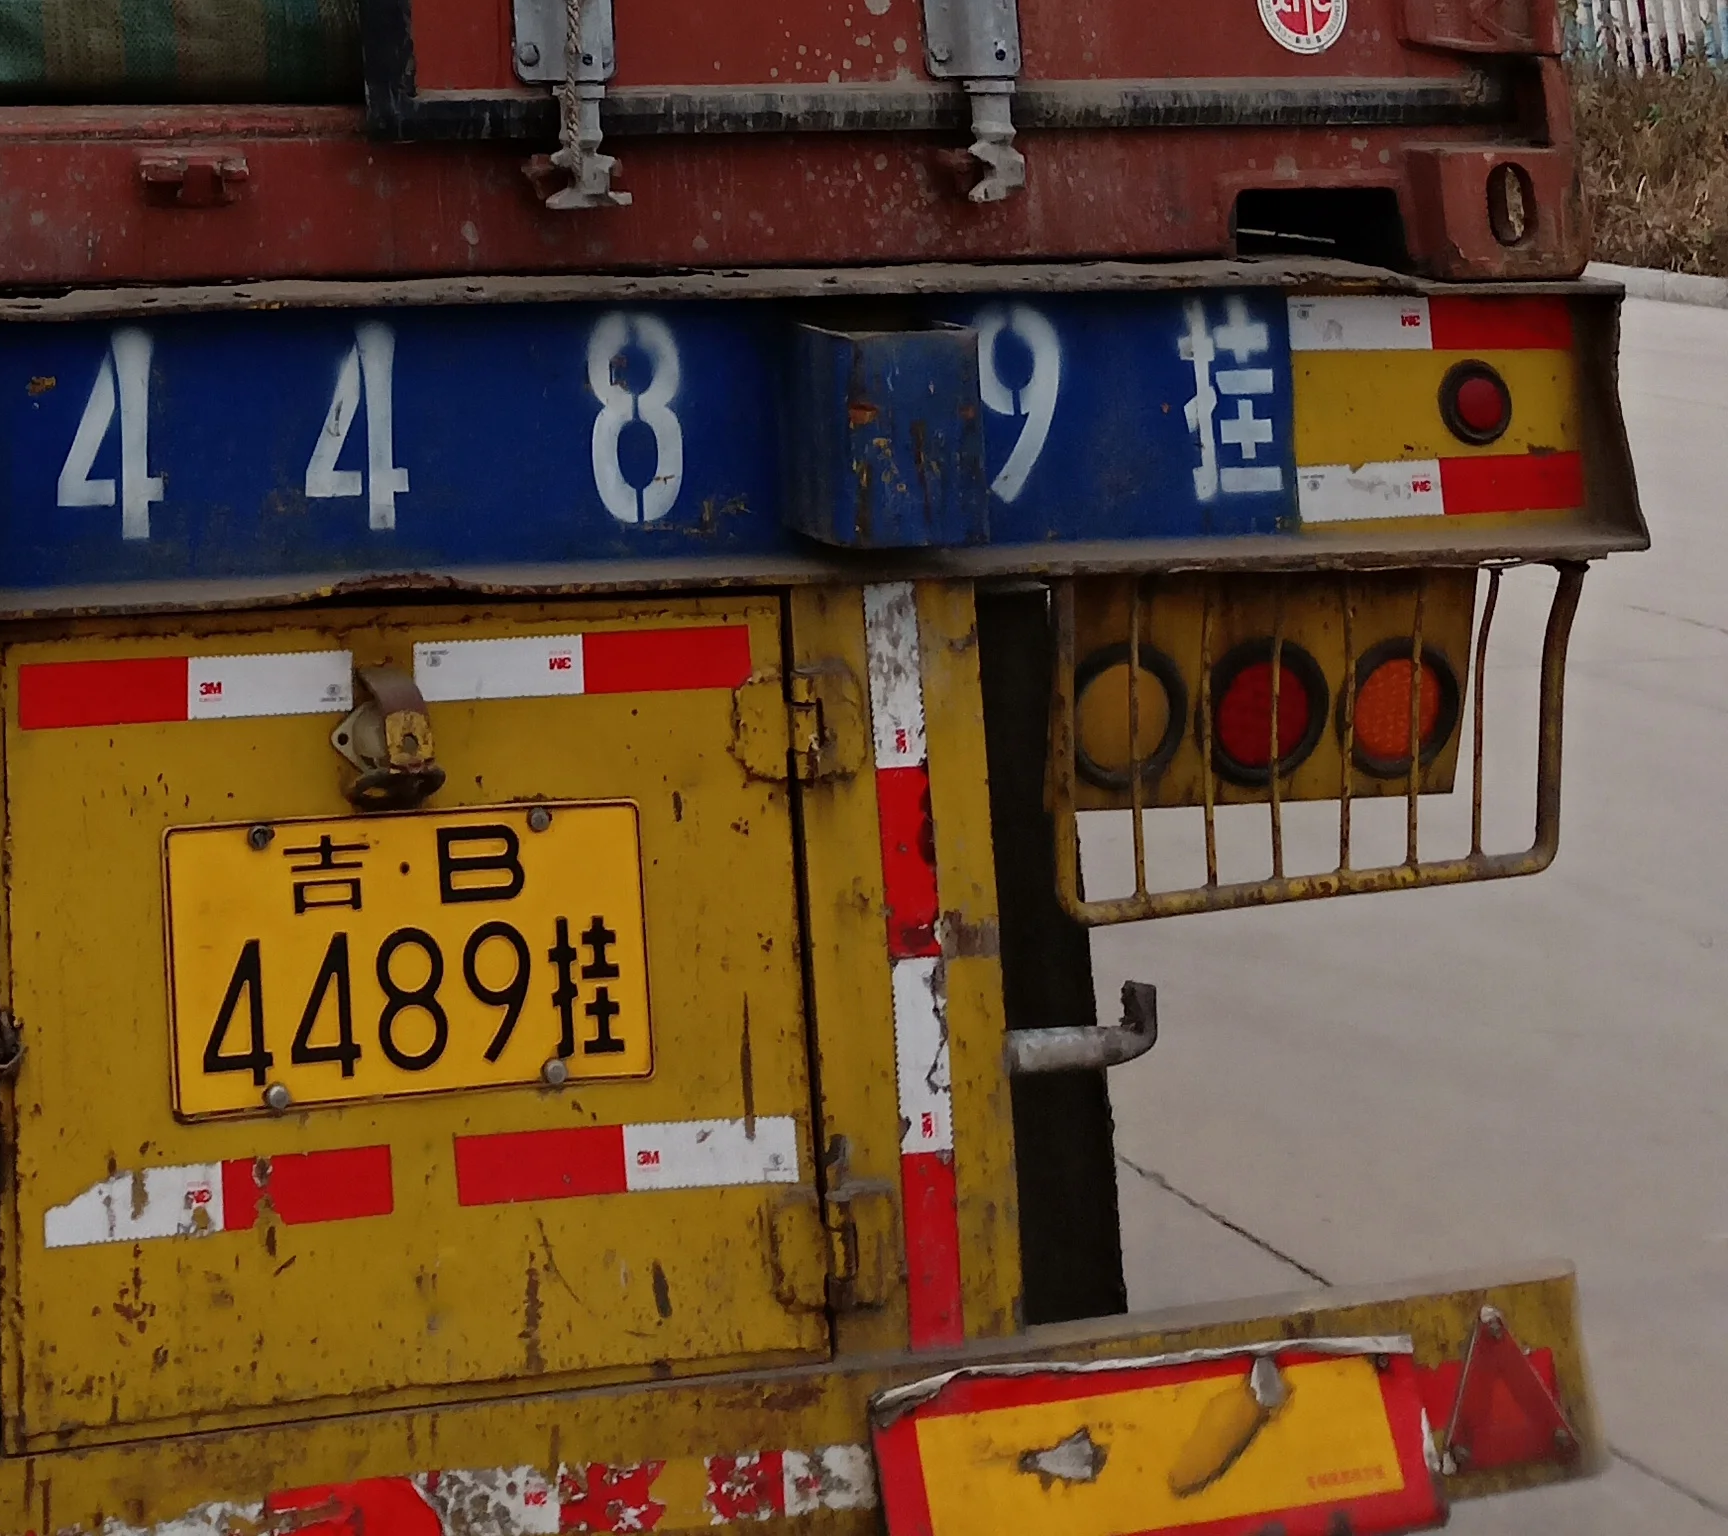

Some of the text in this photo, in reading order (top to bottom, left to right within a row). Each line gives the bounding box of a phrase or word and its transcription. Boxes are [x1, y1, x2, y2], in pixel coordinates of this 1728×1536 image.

[548, 657, 572, 670] 3M
[199, 681, 222, 695] 3M
[203, 915, 625, 1086] 4489挂
[637, 1150, 660, 1165] 3M
